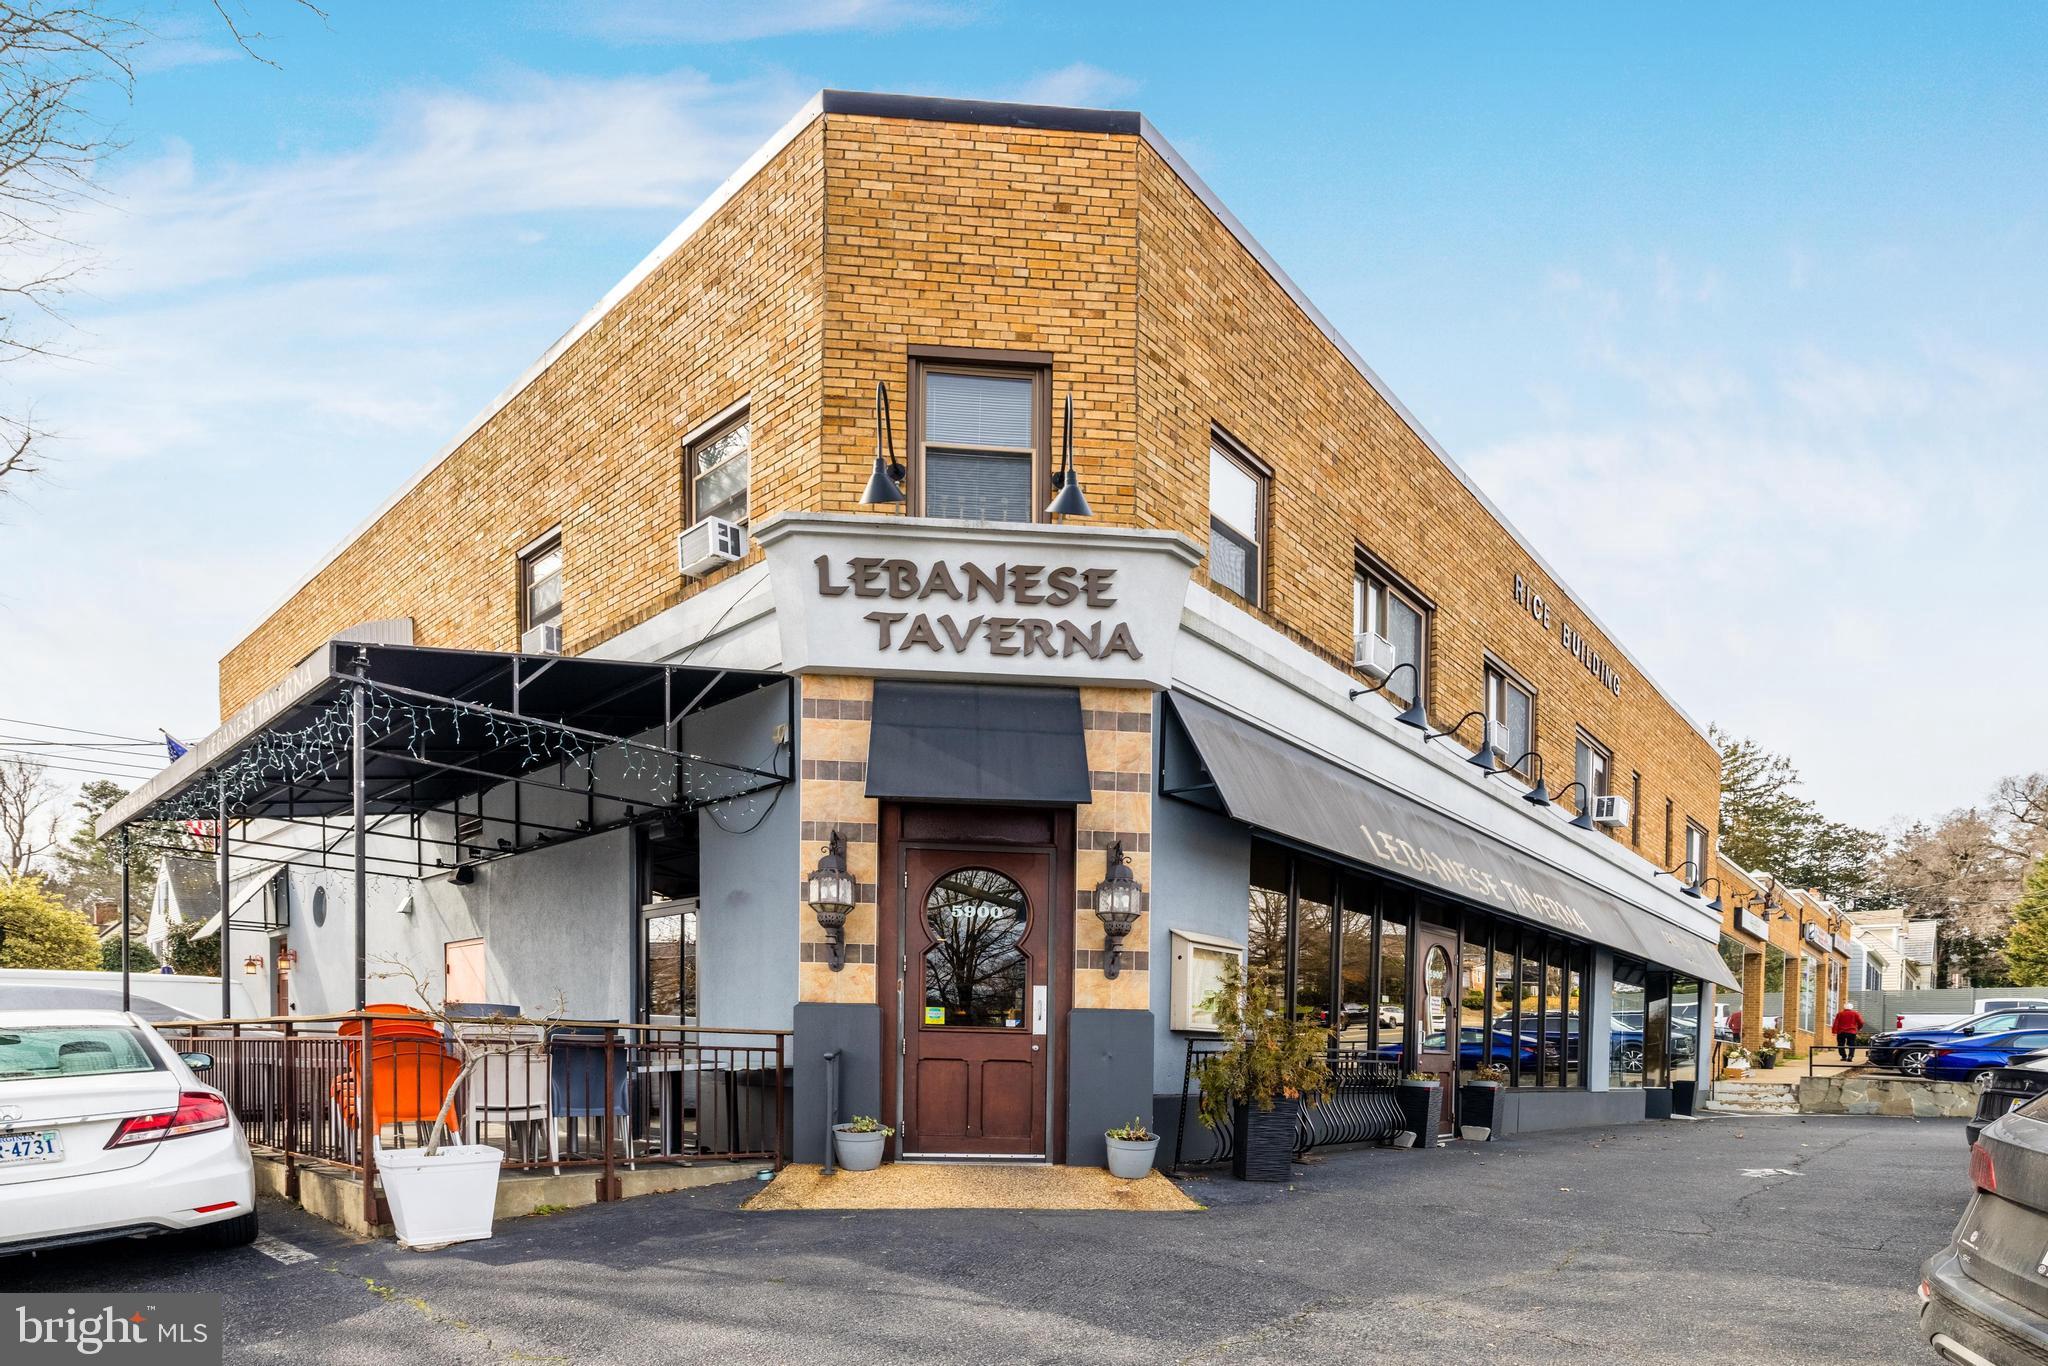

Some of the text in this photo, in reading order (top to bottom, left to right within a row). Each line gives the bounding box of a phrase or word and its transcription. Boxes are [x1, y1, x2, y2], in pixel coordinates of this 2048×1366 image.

[813, 554, 1118, 608] LEBANESE
[863, 611, 1144, 661] TAVERNA
[1514, 573, 1620, 697] RICE BUILDING
[206, 663, 313, 759] LEBANESE TAVERNA
[951, 905, 1003, 918] 5900
[1360, 825, 1592, 933] LEBANESE TAVERNA
